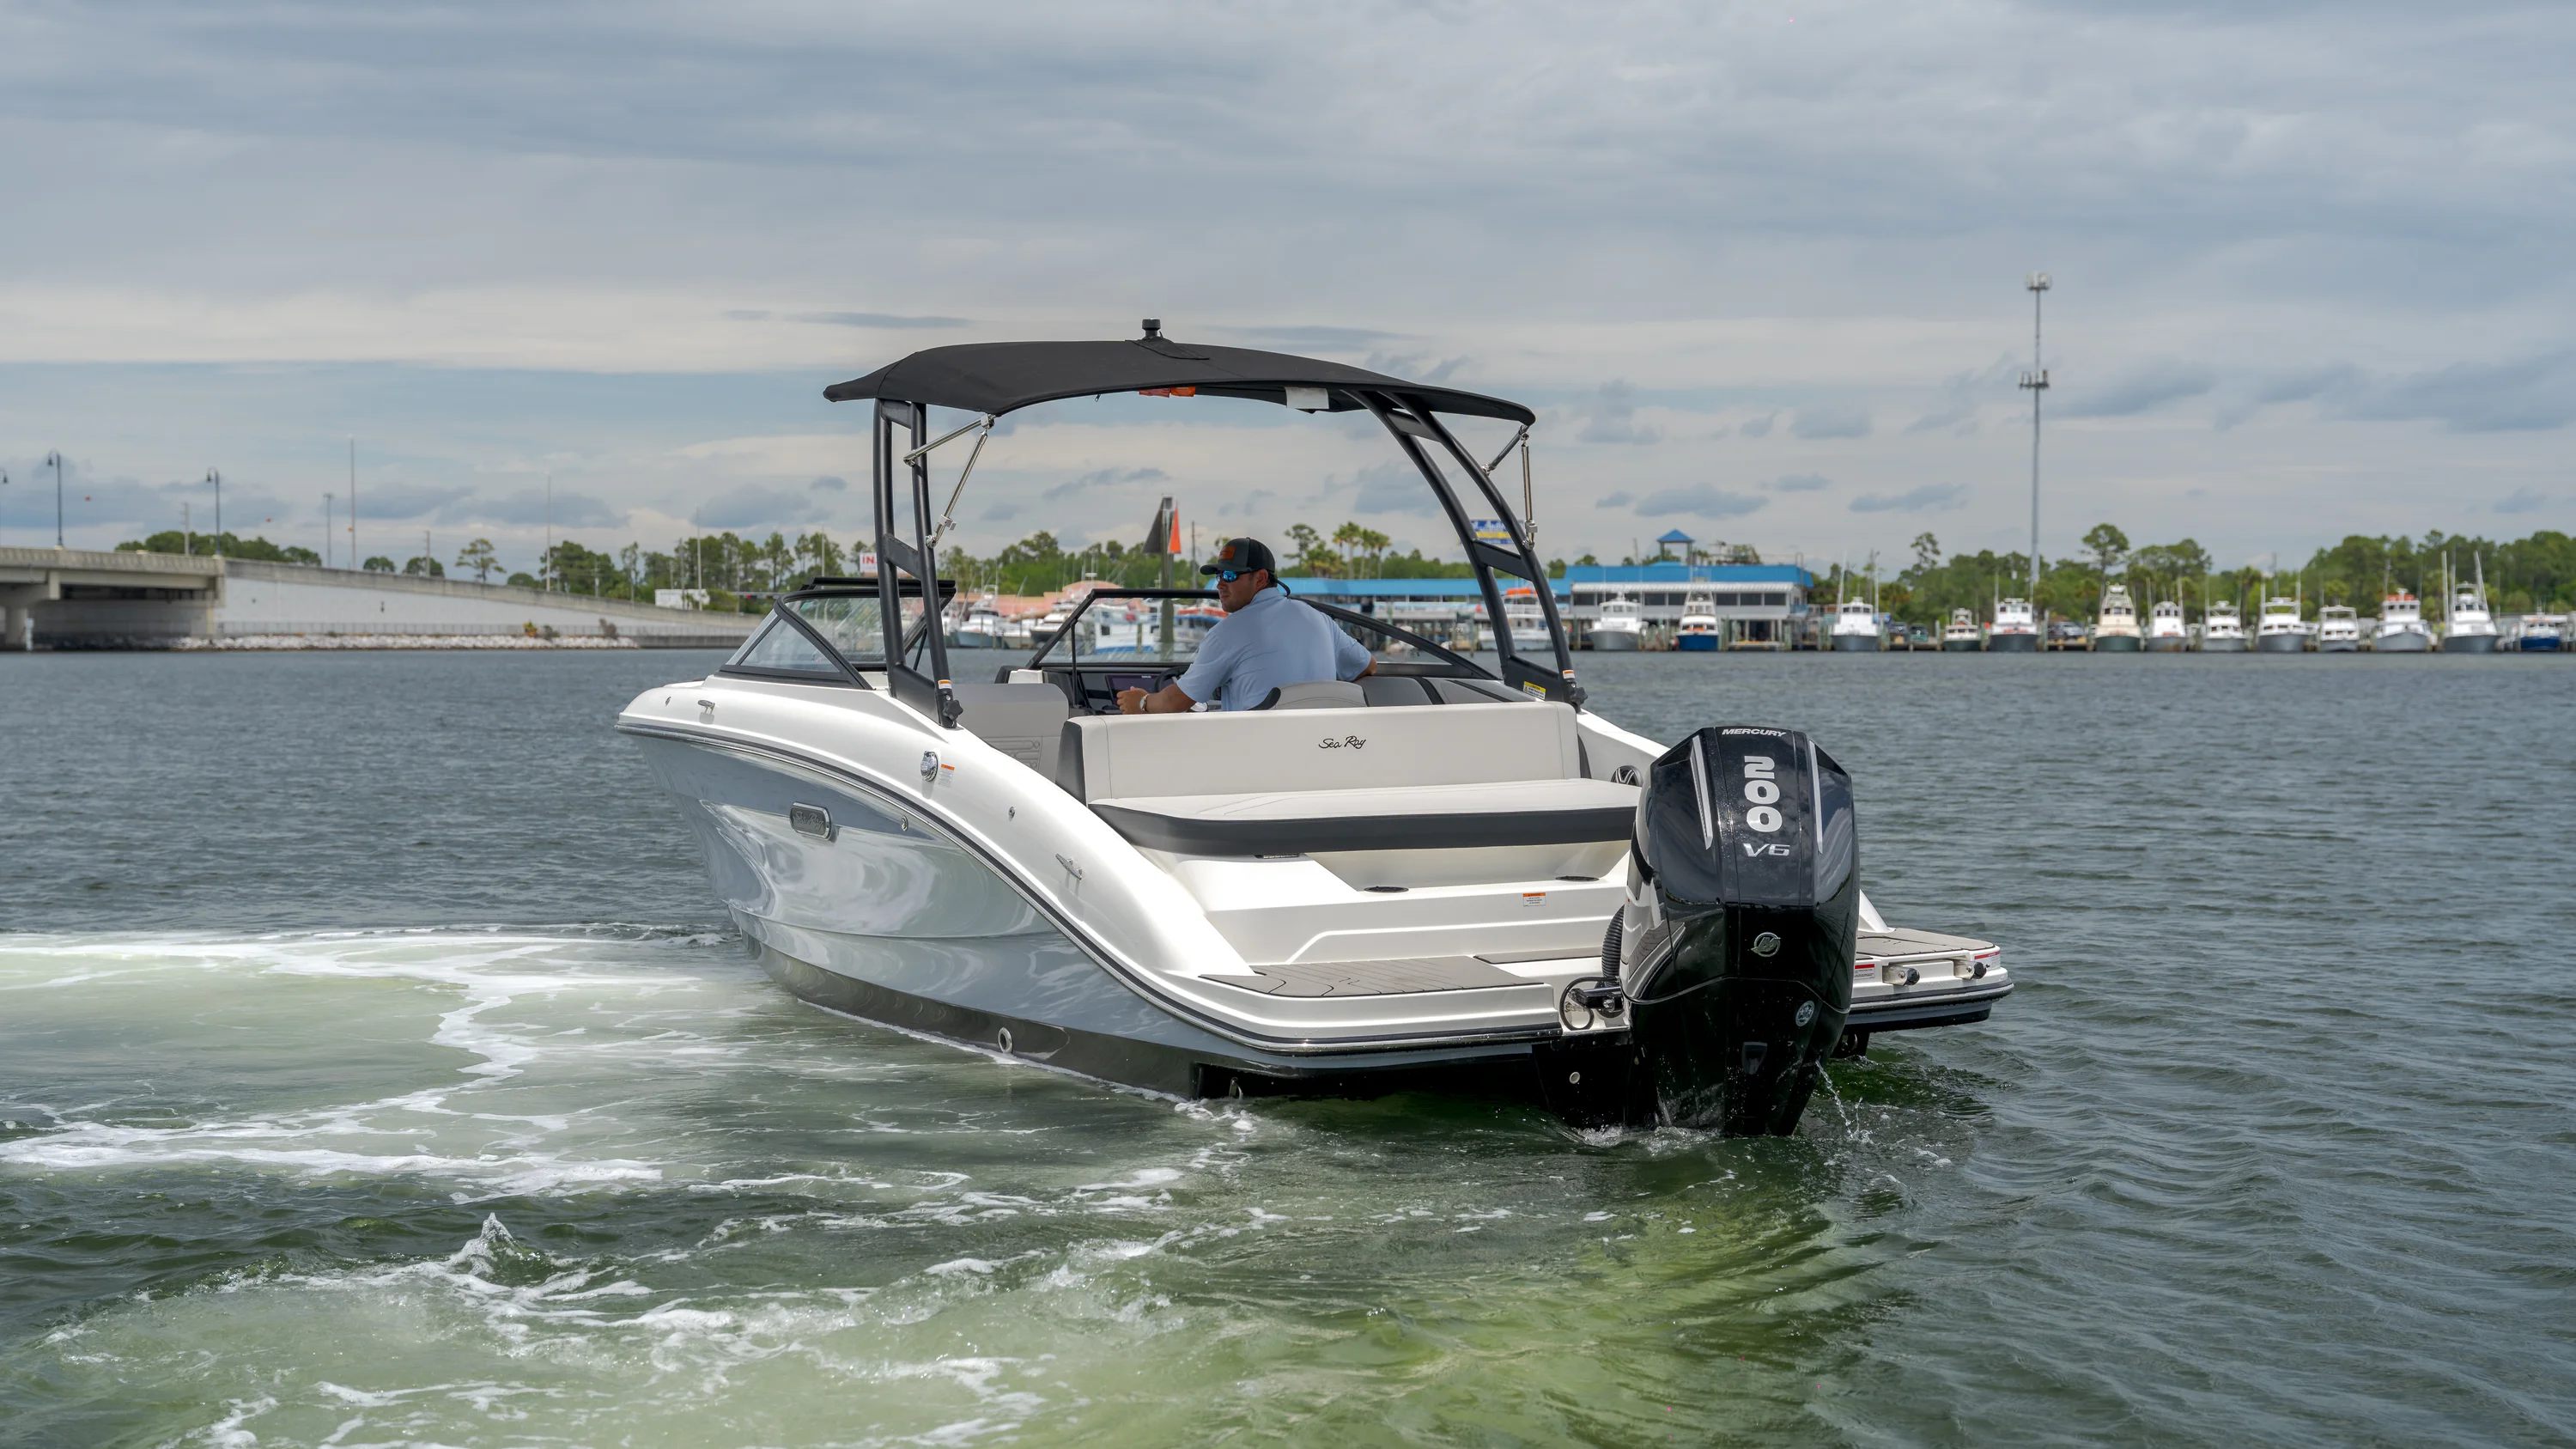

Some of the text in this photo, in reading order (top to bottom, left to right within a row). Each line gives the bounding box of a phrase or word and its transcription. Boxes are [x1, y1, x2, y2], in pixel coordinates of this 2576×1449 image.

[862, 556, 878, 564] IN
[1722, 728, 1787, 737] MERCURY
[1318, 735, 1367, 750] Sea Ray
[1744, 755, 1783, 833] 200
[1743, 843, 1790, 857] V6
